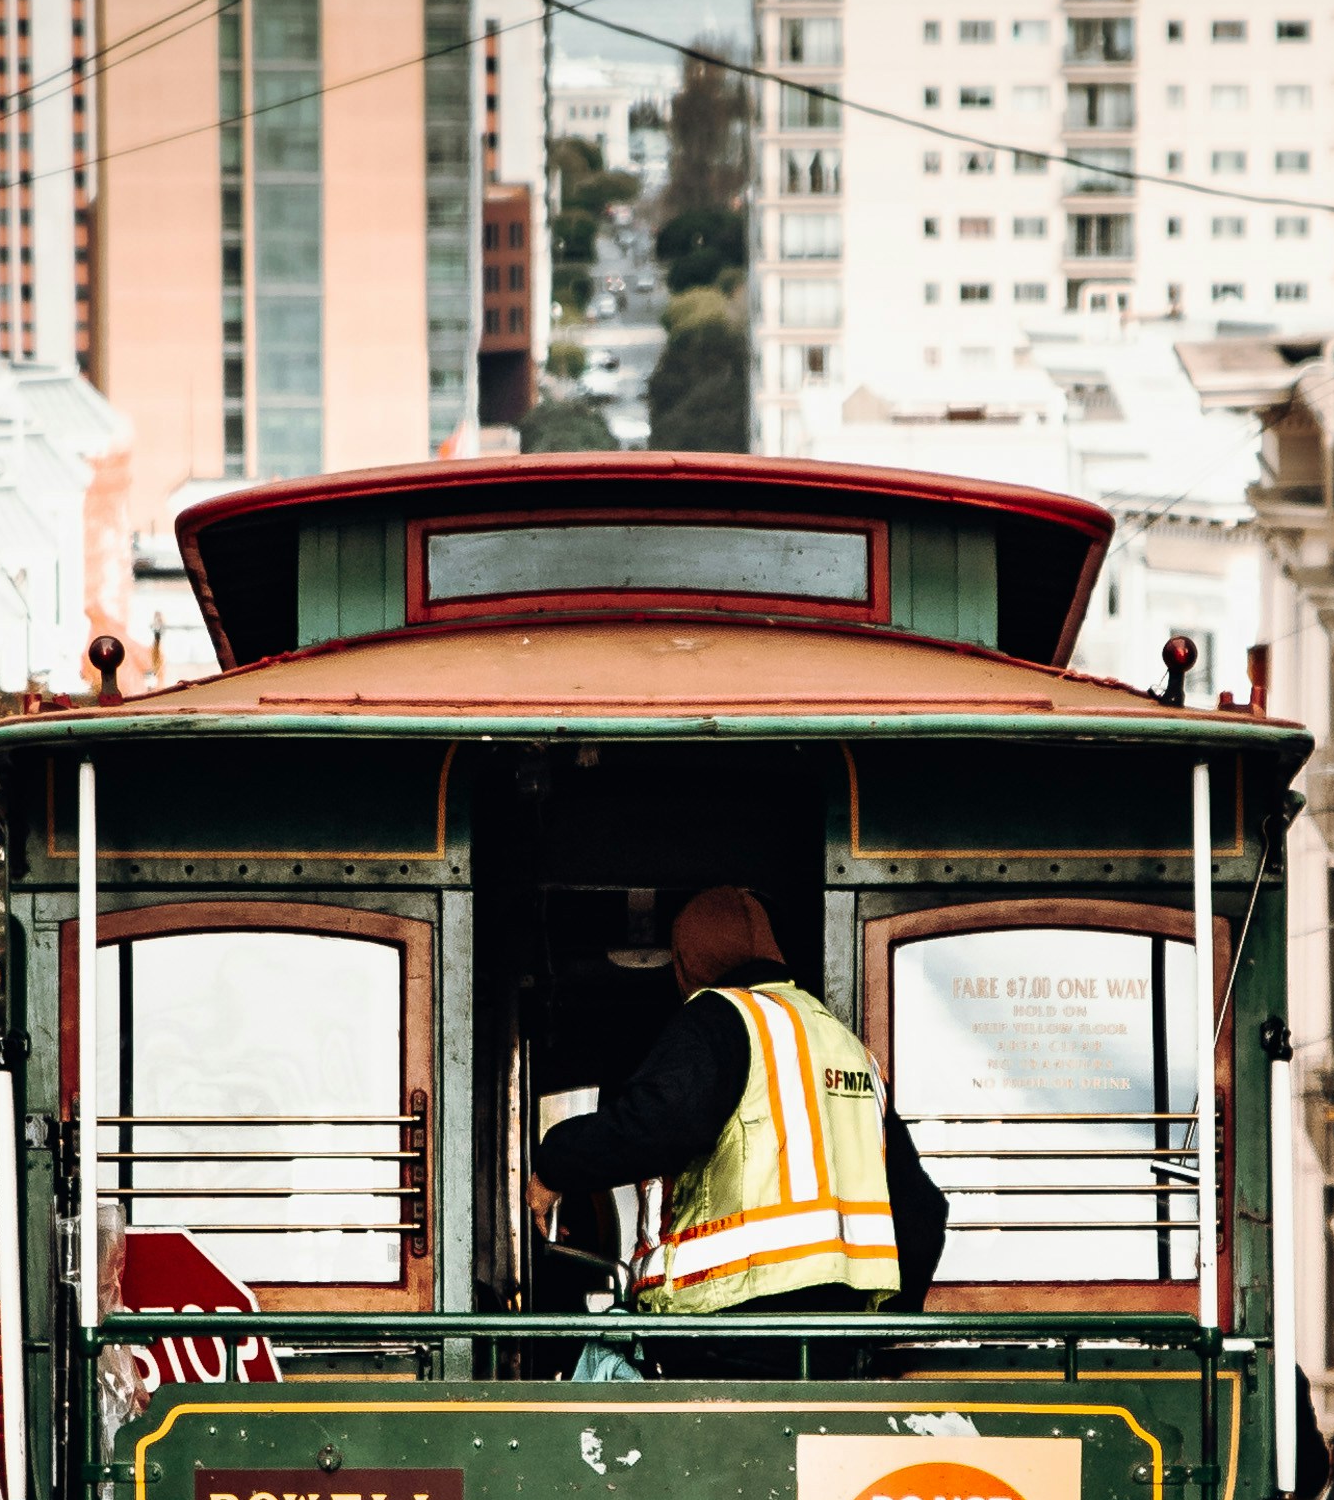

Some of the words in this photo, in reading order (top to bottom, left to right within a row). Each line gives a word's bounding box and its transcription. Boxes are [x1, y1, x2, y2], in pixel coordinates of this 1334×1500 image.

[952, 976, 999, 999] FARE
[1057, 978, 1099, 999] ONE
[1106, 978, 1149, 999] WAY
[1013, 1005, 1057, 1018] HOLD
[1062, 1005, 1087, 1018] ON
[825, 1067, 874, 1092] SFMTA
[972, 1077, 996, 1090] NO
[1080, 1077, 1131, 1091] DRINK
